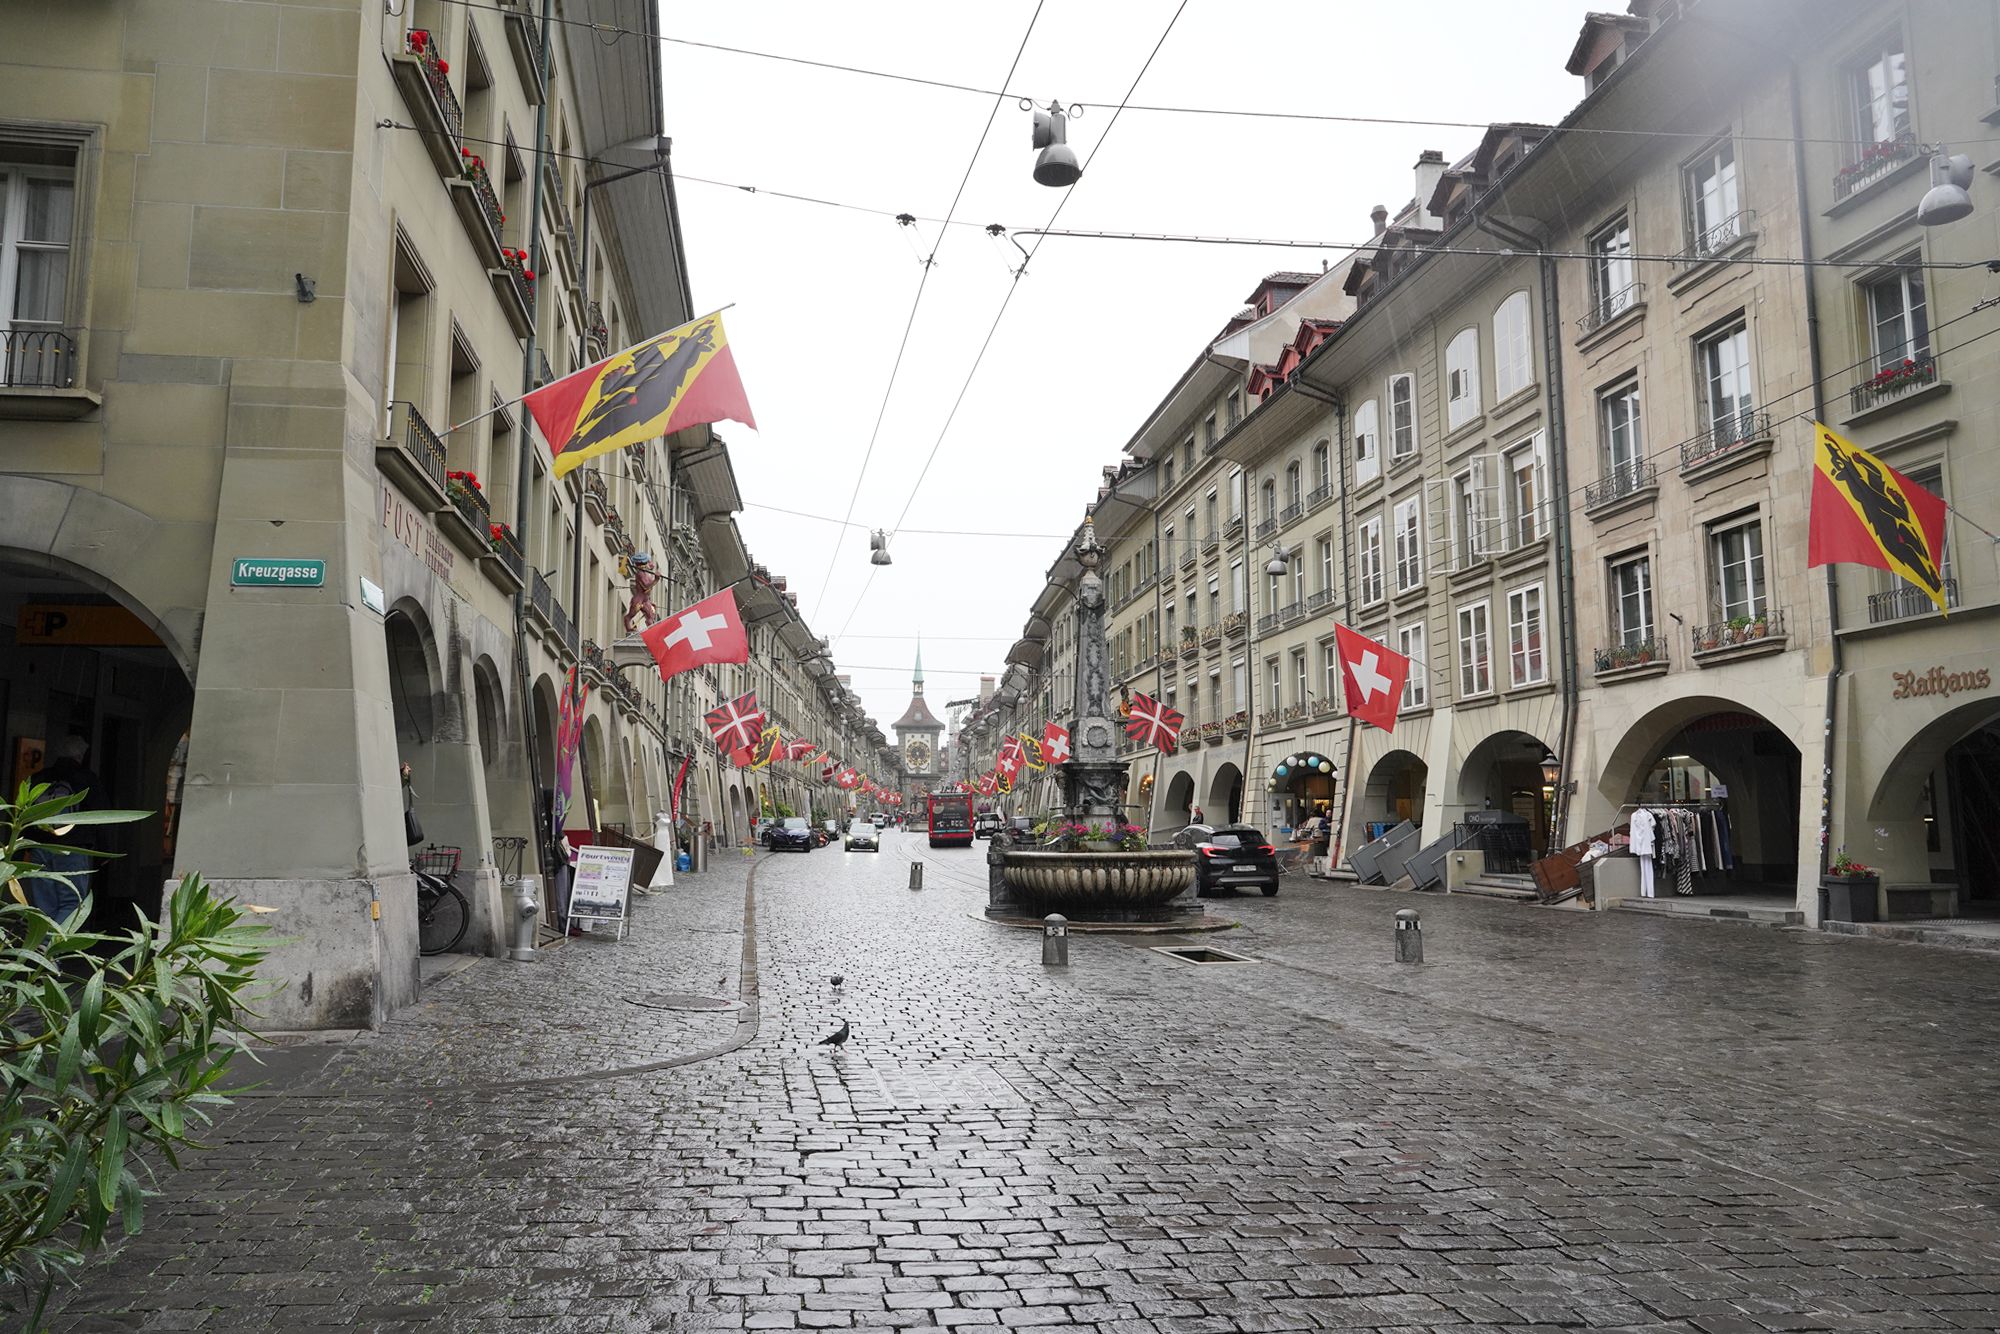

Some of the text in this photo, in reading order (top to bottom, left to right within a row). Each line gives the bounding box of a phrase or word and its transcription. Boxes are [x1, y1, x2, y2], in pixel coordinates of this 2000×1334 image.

[383, 486, 422, 557] POST
[238, 562, 318, 582] Kreuzgasse
[1892, 665, 1991, 699] Rathaus
